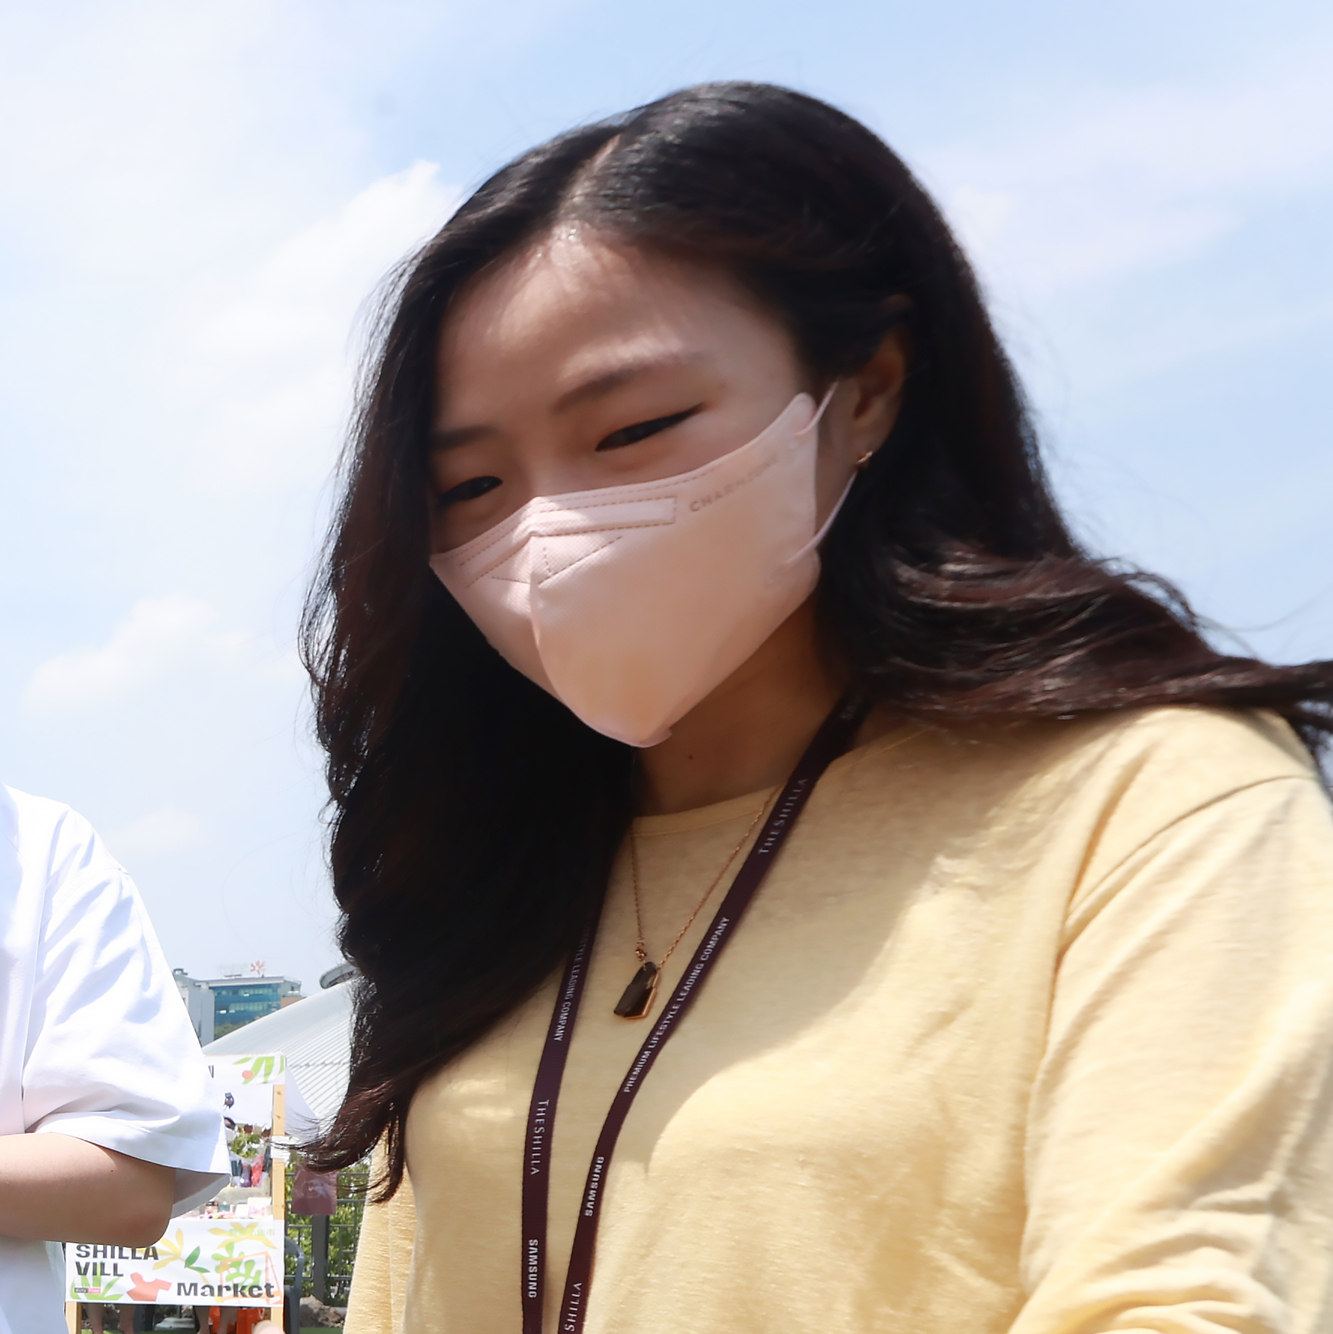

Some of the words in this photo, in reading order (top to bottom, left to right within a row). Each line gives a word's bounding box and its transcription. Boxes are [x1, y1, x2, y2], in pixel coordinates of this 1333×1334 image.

[563, 962, 582, 1004] LEADING
[553, 1001, 572, 1042] COMPANY
[624, 1050, 652, 1093] PREMIUM
[648, 1003, 680, 1049] LIFESTYLE
[676, 963, 704, 1002] LEADING
[700, 916, 730, 961] COMPANY
[584, 1155, 605, 1217] SAMSUNG
[75, 1243, 160, 1261] SHILLA
[75, 1261, 125, 1278] VILL
[528, 1238, 539, 1298] SAMSUNG
[176, 1281, 276, 1299] Market
